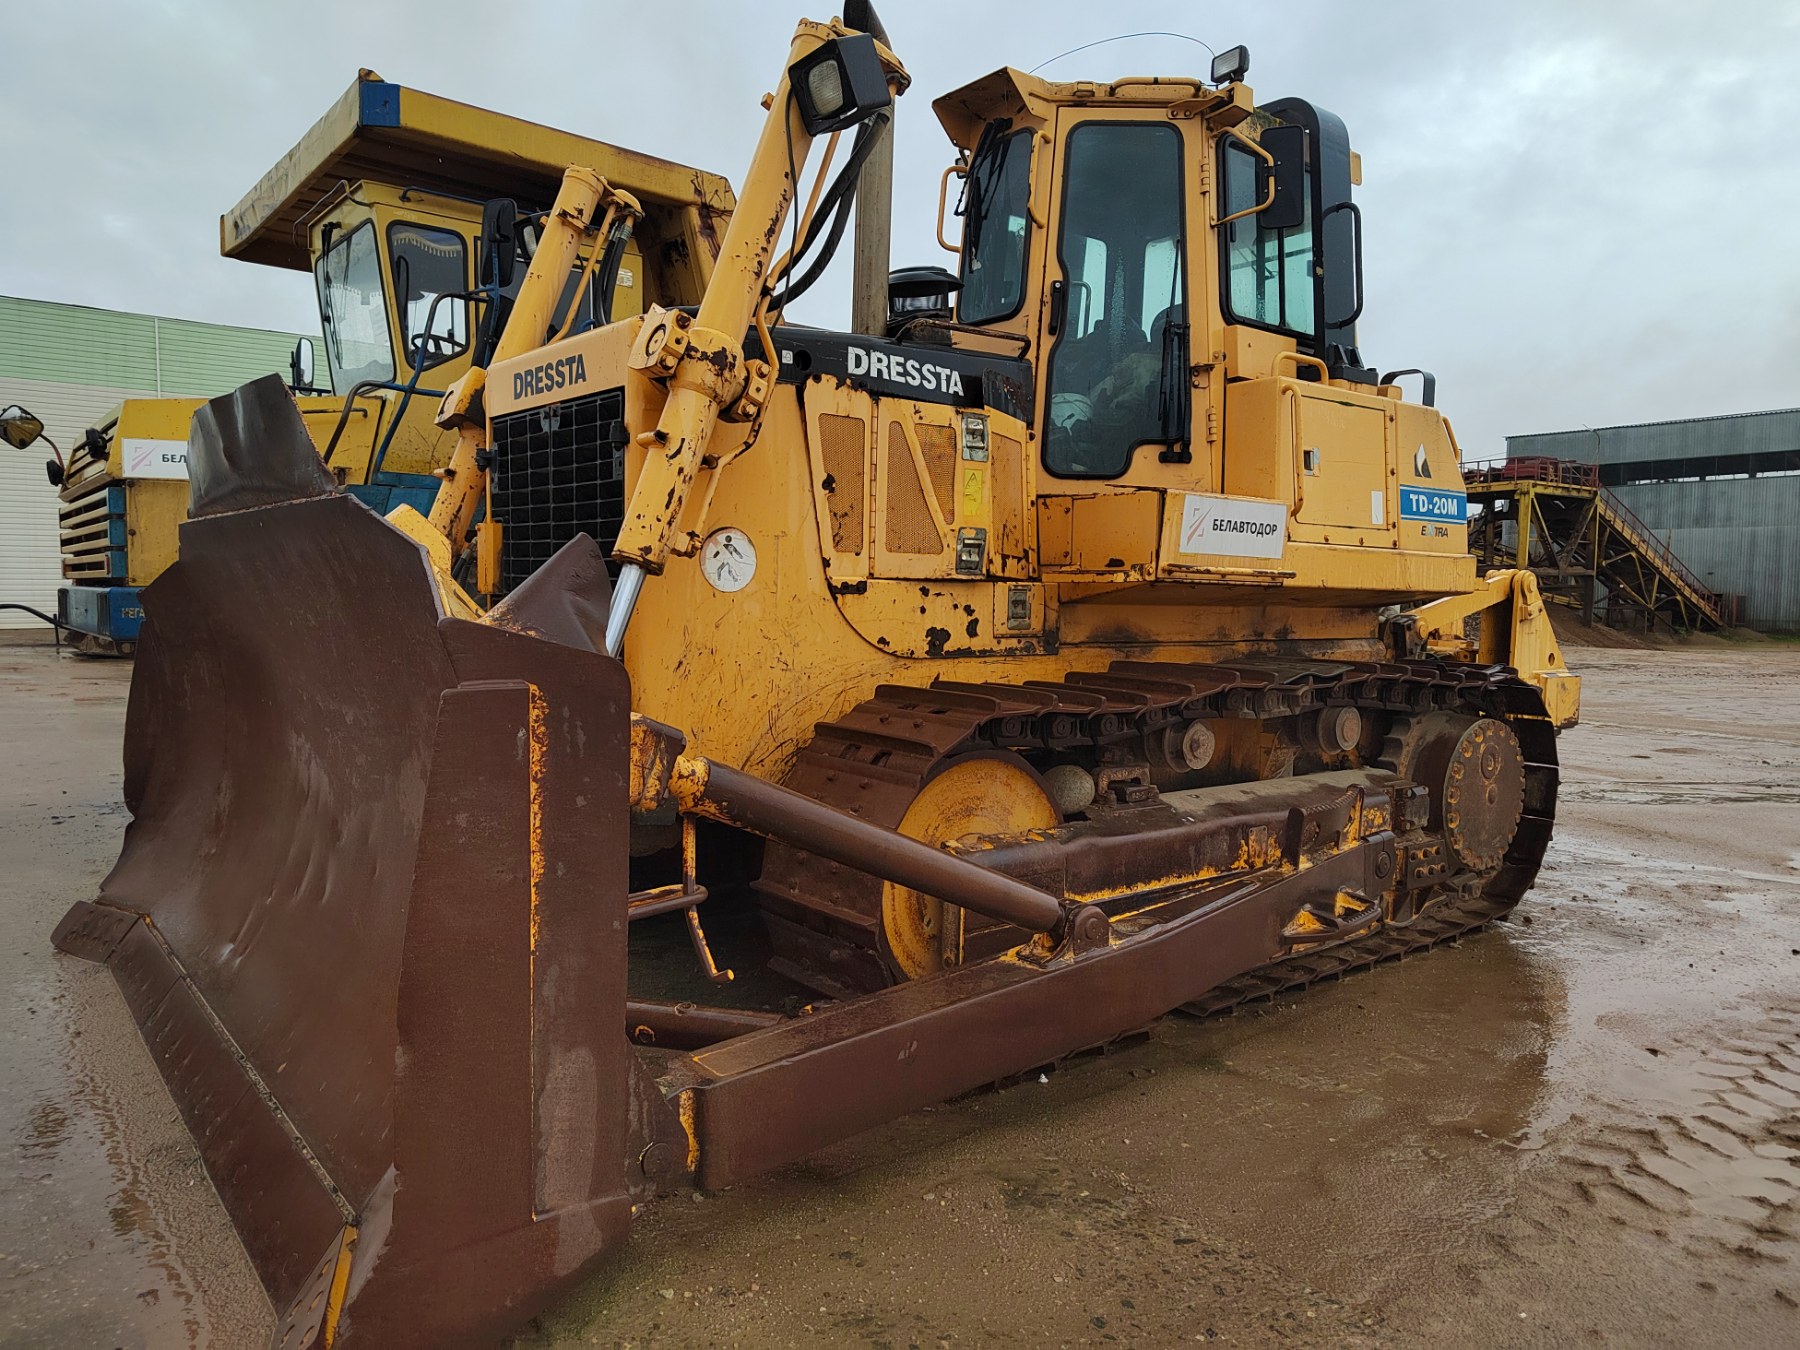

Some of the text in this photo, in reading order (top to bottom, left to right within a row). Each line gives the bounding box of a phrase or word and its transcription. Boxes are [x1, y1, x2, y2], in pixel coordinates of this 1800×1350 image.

[513, 353, 587, 400] DRESSTA
[846, 346, 964, 396] DRESSTA
[1410, 493, 1458, 516] TD-20M
[1212, 518, 1278, 538] БЕЛАВТОДОР
